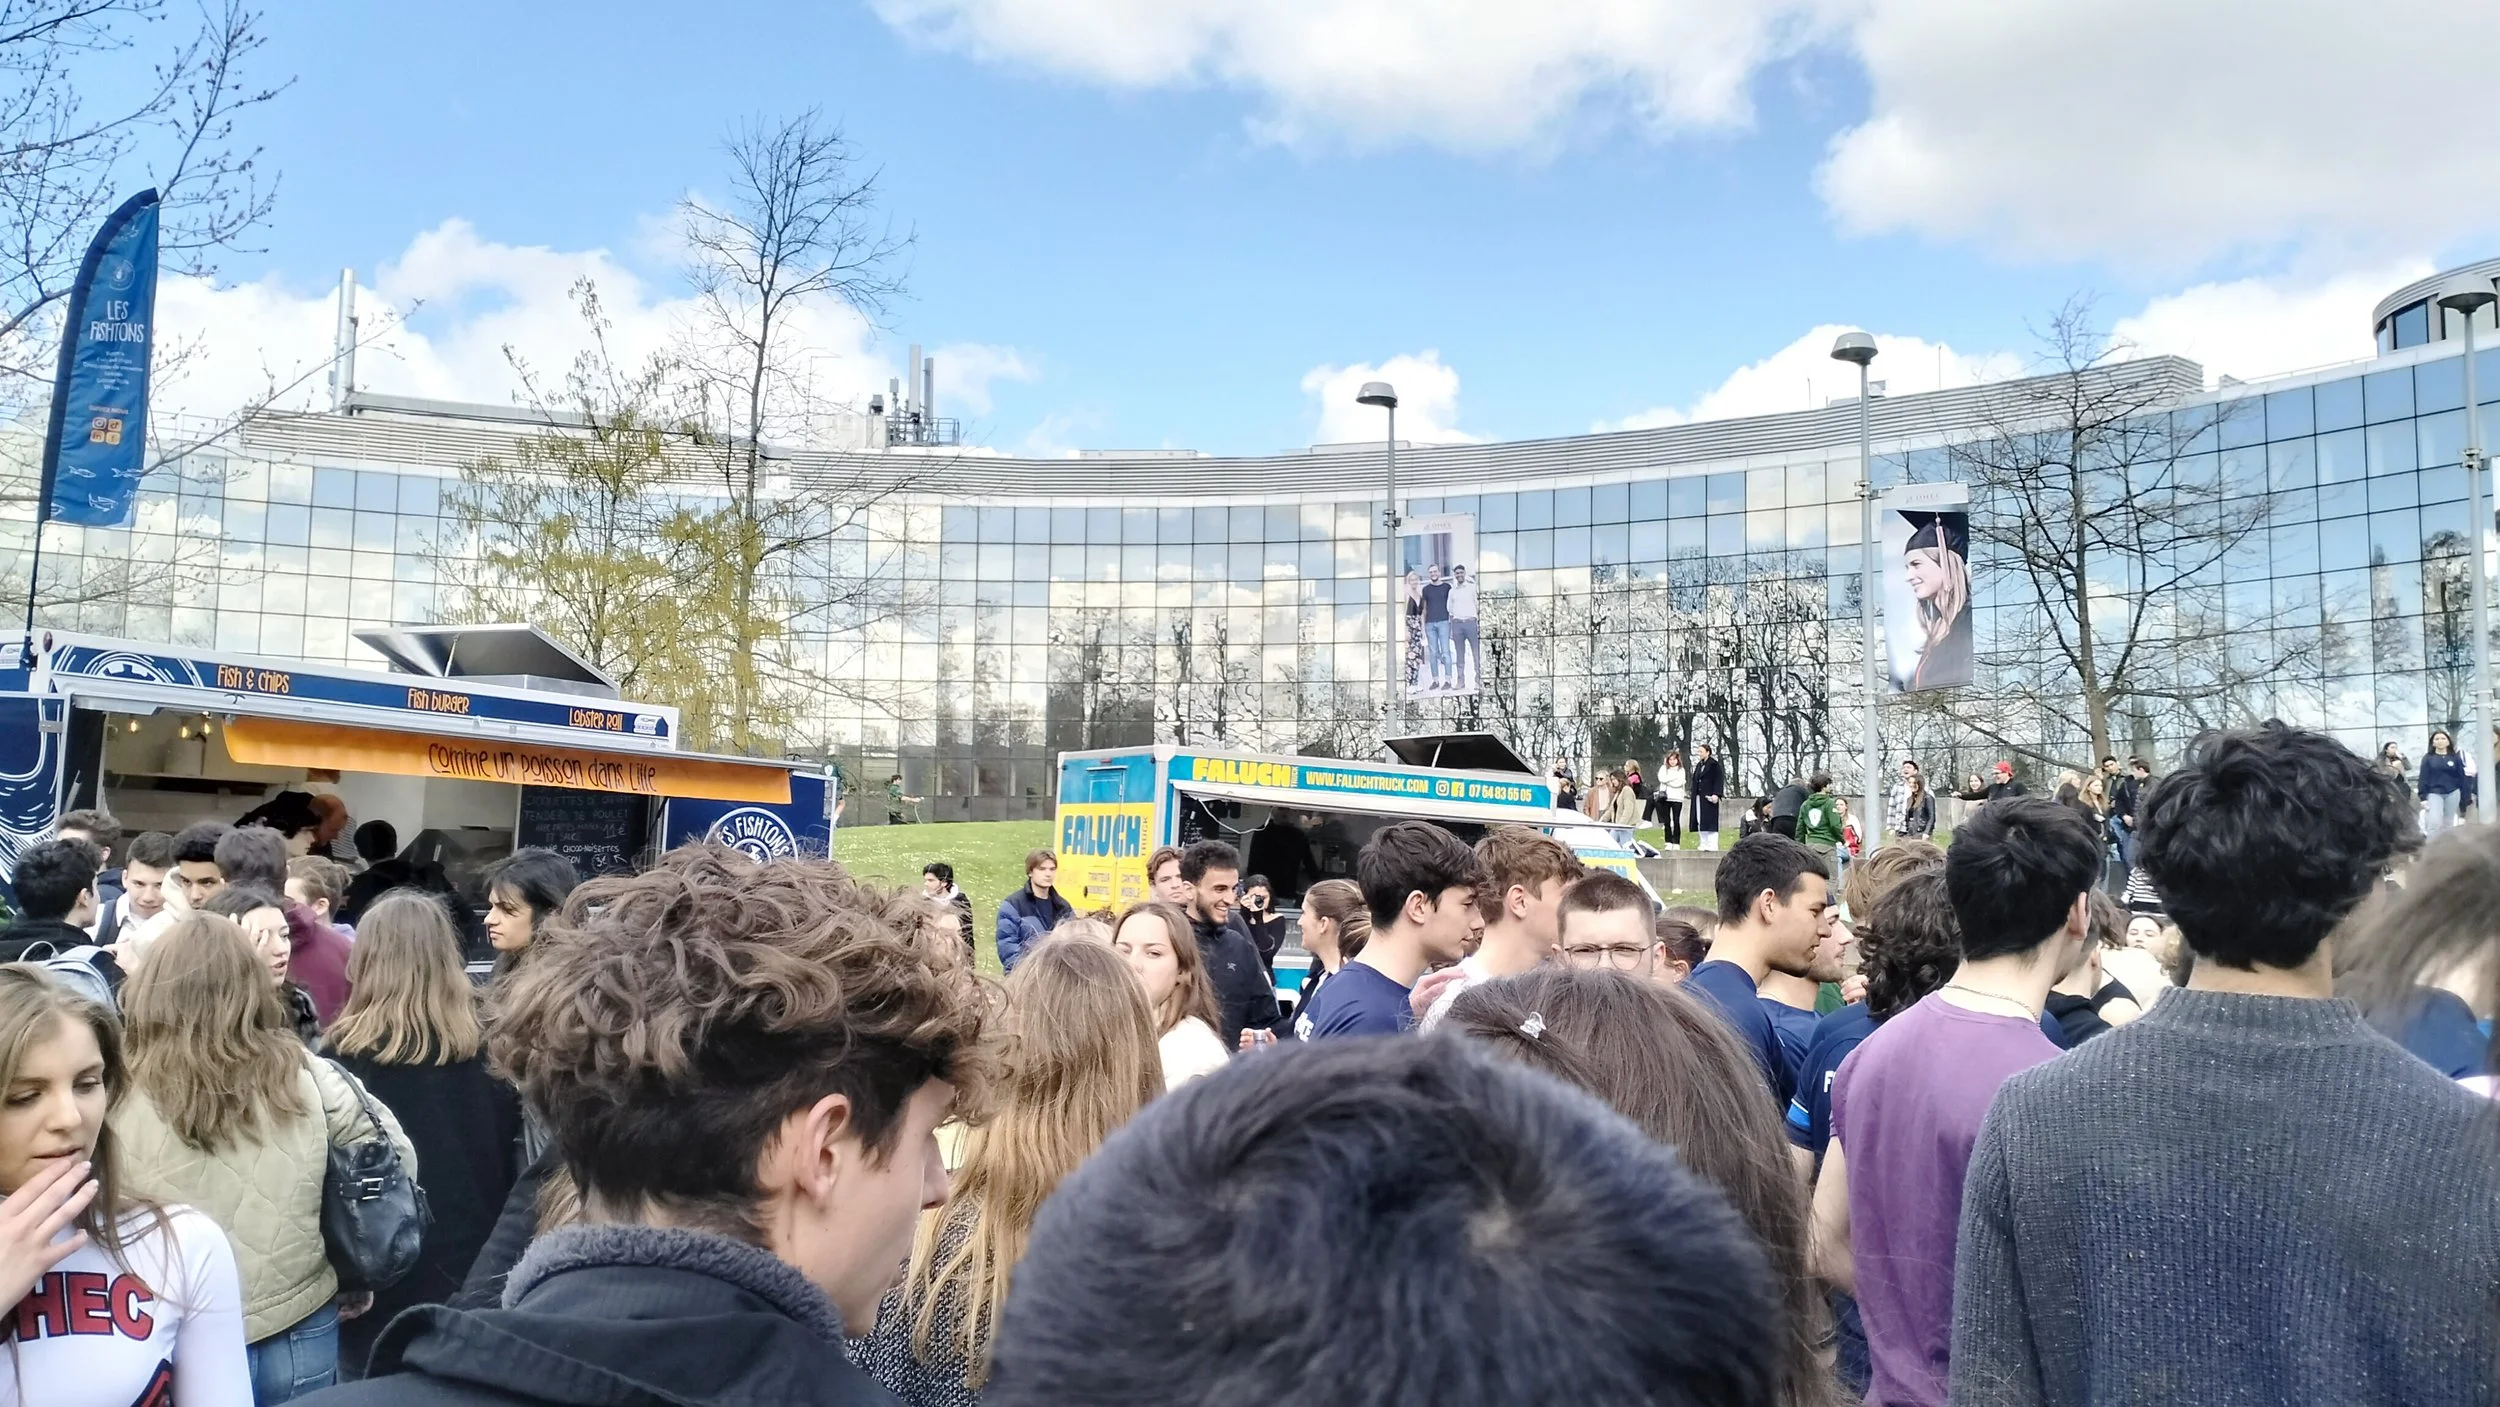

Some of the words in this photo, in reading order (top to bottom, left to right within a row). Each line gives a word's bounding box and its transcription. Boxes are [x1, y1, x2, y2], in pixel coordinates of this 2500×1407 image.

[107, 300, 129, 321] LES
[90, 321, 144, 343] FISHTONS
[246, 668, 254, 690] &
[429, 742, 491, 778] Comme
[587, 757, 623, 787] dans
[629, 762, 657, 792] Lille
[1193, 757, 1292, 788] FALUCH
[1306, 770, 1429, 794] WWW.FALUCHTRUCK.COM
[1468, 783, 1481, 798] 07
[1494, 785, 1507, 801] 83
[735, 814, 791, 858] FISHTONS
[1062, 813, 1141, 858] FALUCH
[16, 1270, 154, 1342] HEC
